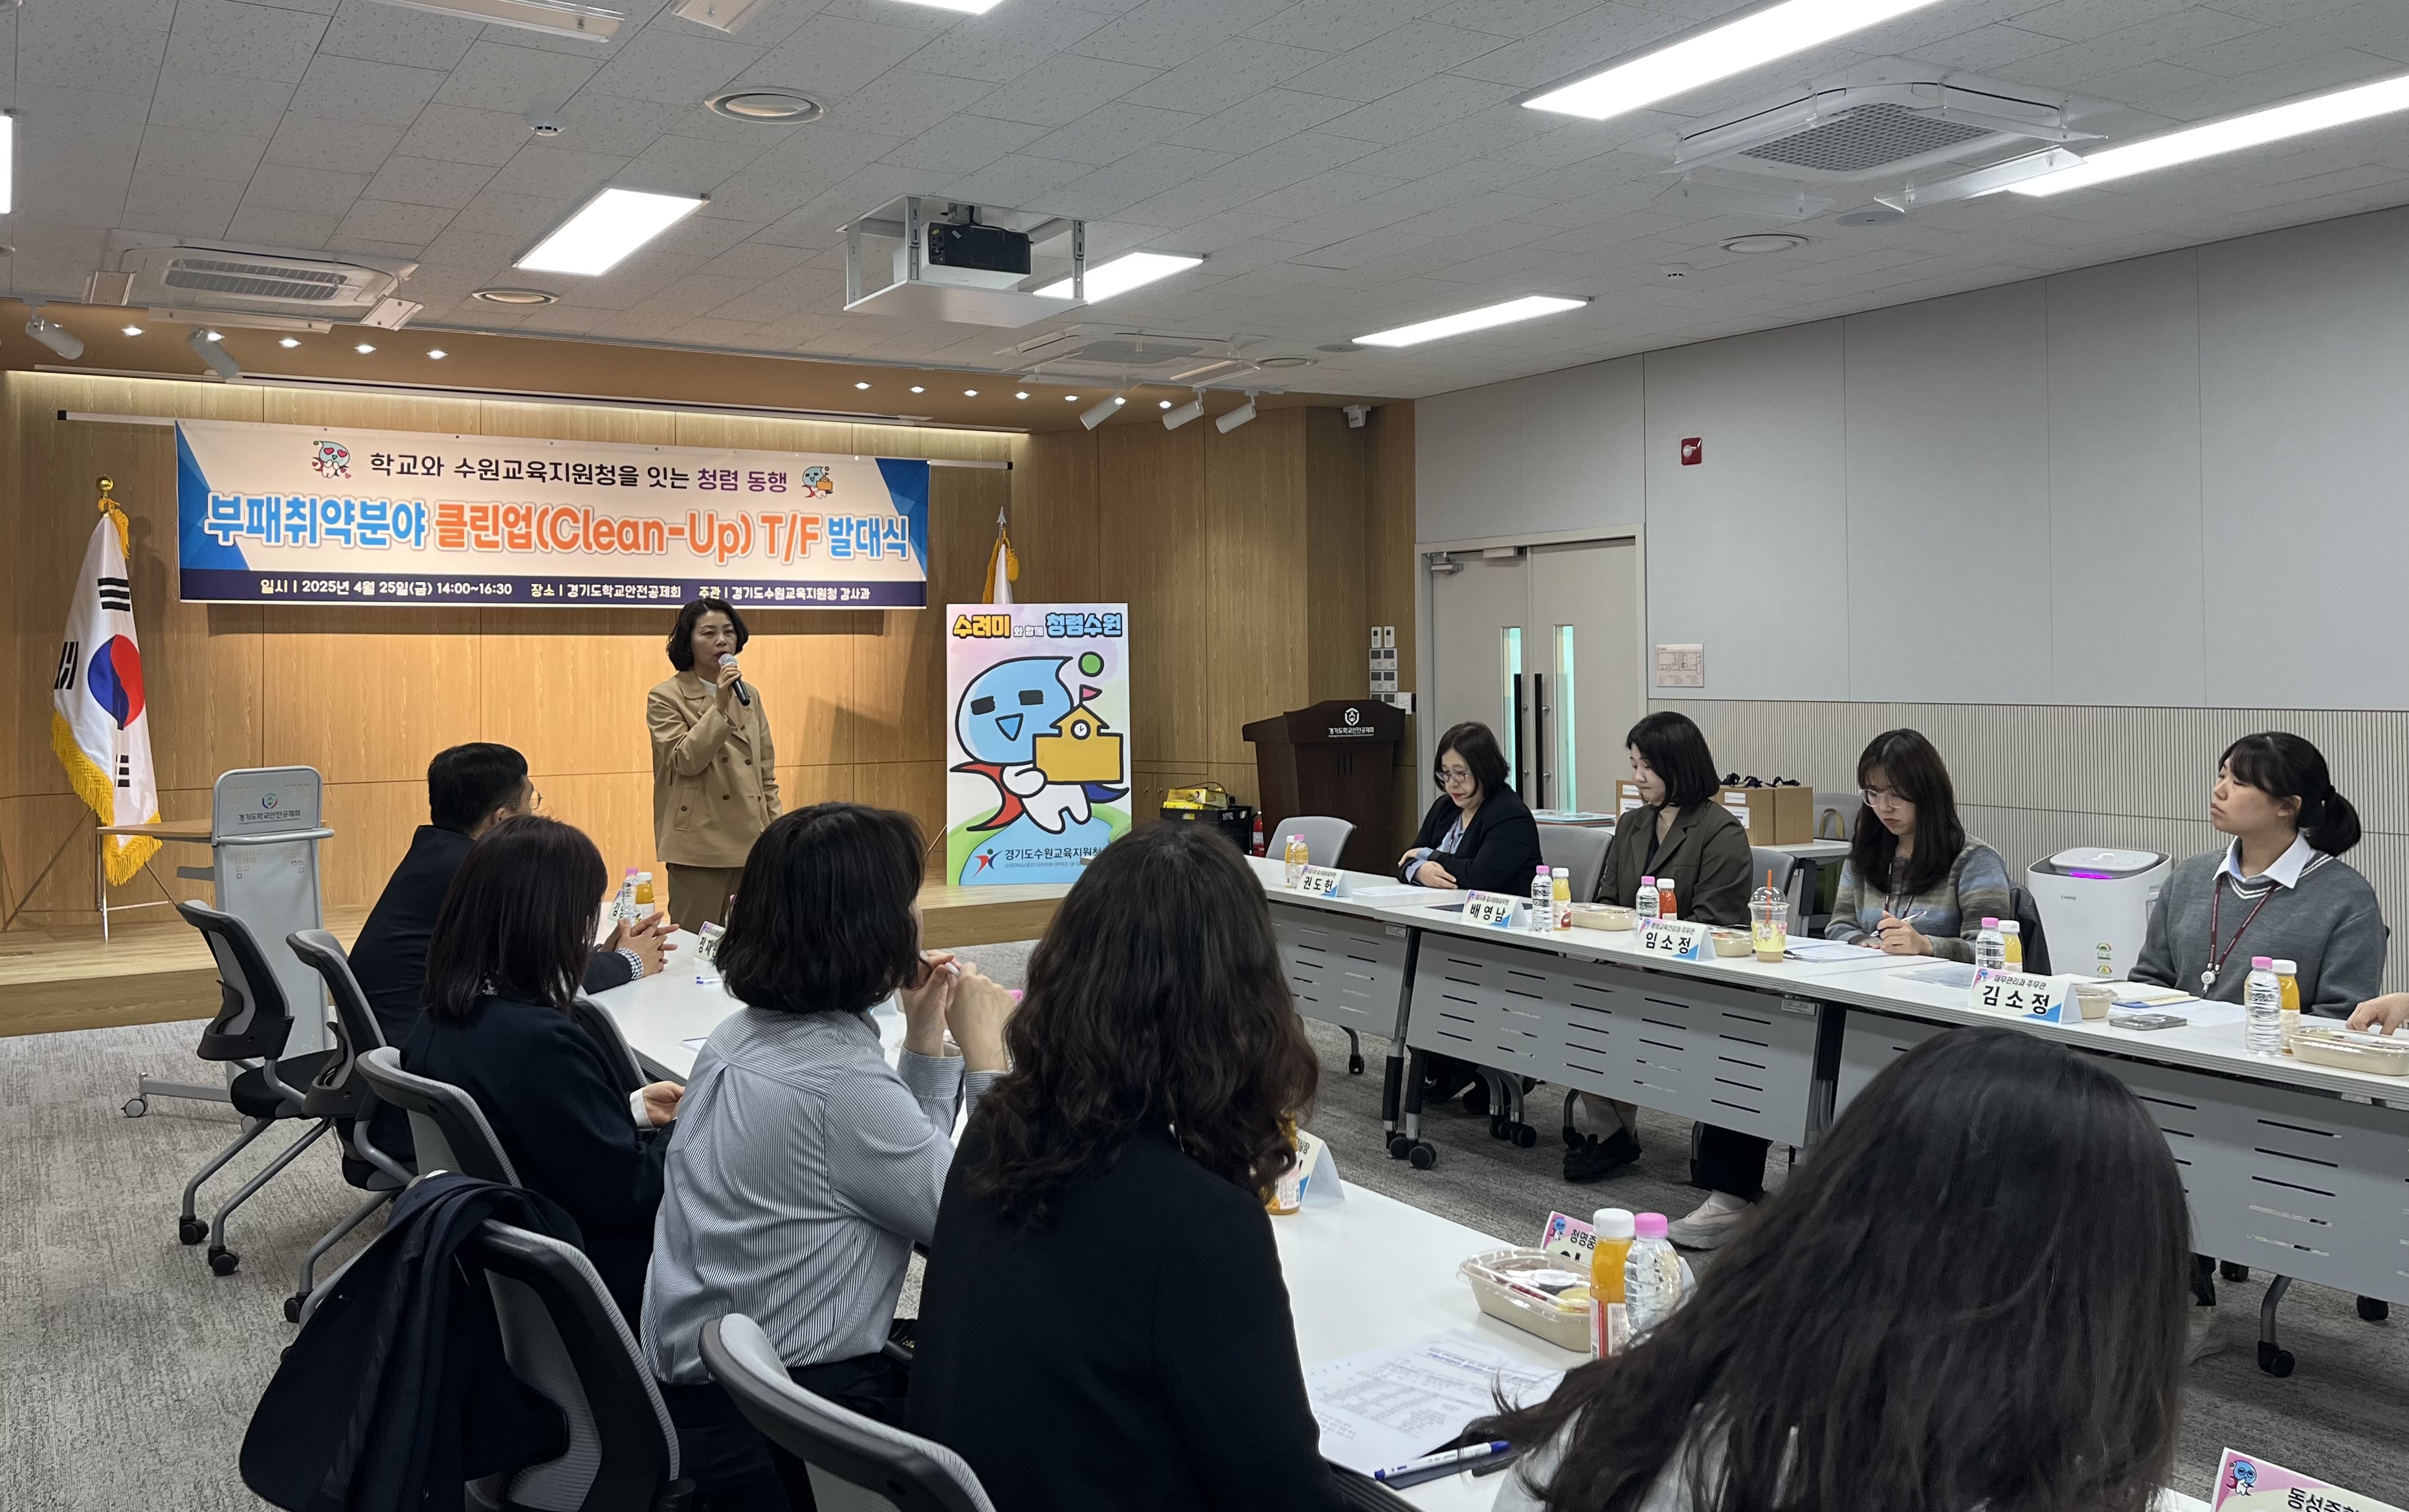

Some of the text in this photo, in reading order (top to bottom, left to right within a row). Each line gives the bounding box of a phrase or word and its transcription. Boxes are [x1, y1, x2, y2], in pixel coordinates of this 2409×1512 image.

[370, 452, 788, 493] 학교와 수원교육지원청을 잇는 청렴 동행
[207, 495, 909, 564] 부패취약분야 클린업(Clean-Up) T/F 발대식
[261, 579, 513, 596] 일시 2025년 4월 25일(금) 14:00~16:30
[531, 583, 681, 599] 장소 경기도학교안전공제회
[698, 586, 871, 601] 주관 경기도수원교육지원청 감사과
[953, 614, 1011, 639] 수려미
[1045, 612, 1123, 638] 청렴수원
[1646, 932, 1691, 954] 임소정
[1994, 974, 2047, 990] 재무관리과 주무관
[1982, 985, 2050, 1014] 김소정
[2287, 1487, 2360, 1512] 동성중
